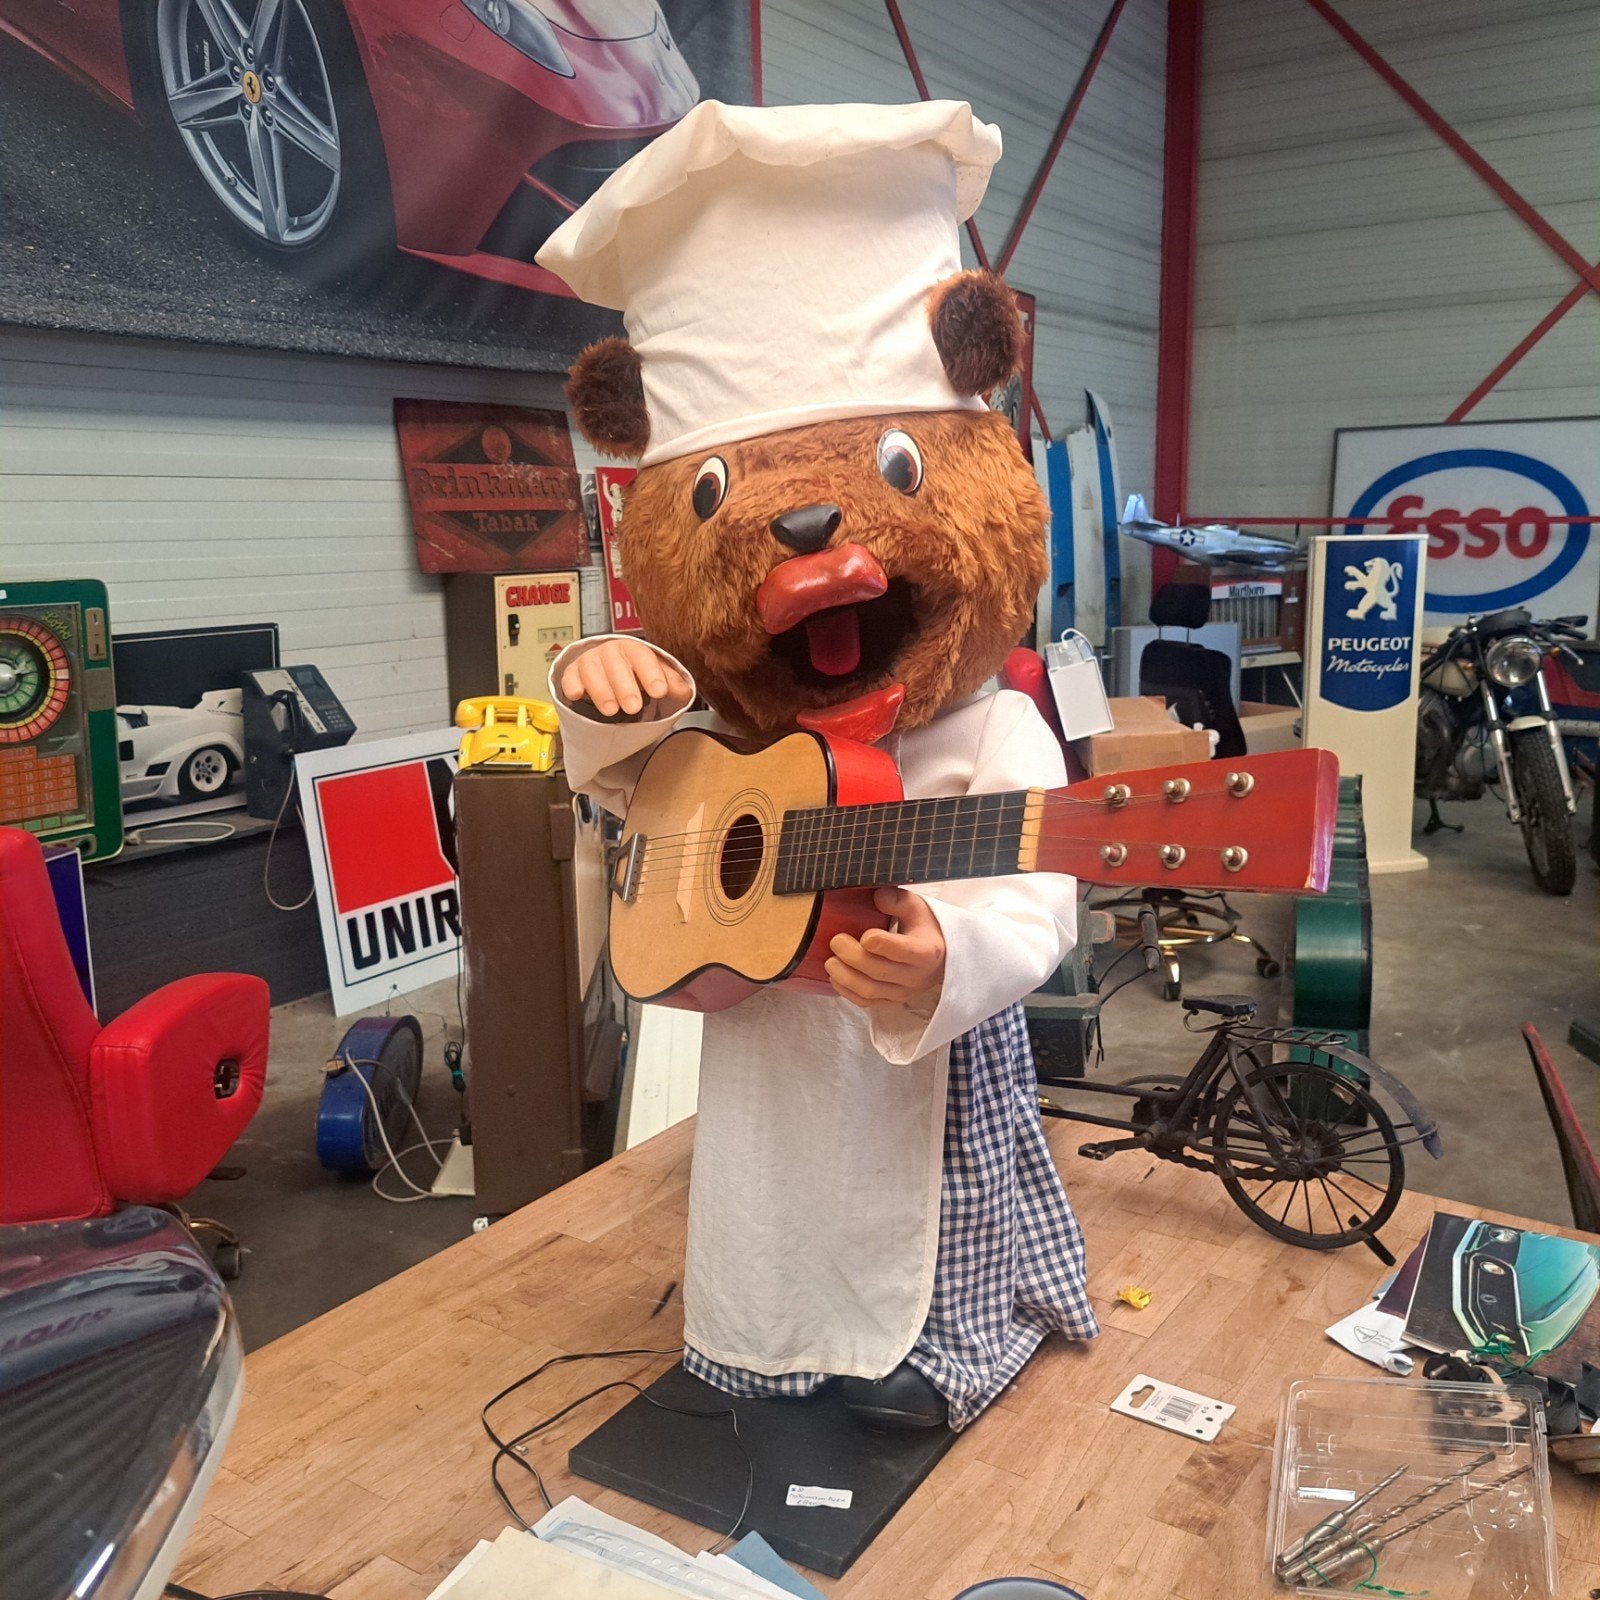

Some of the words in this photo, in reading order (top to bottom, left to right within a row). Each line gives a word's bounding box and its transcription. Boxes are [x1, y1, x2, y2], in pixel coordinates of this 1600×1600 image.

[473, 513, 540, 533] Tabak
[1386, 495, 1550, 560] Esso
[505, 583, 571, 608] CHANGE
[1228, 584, 1265, 597] Marlboro
[1327, 636, 1412, 652] PEUGEOT
[1325, 654, 1410, 681] Motocycles
[347, 888, 463, 971] UNIR
